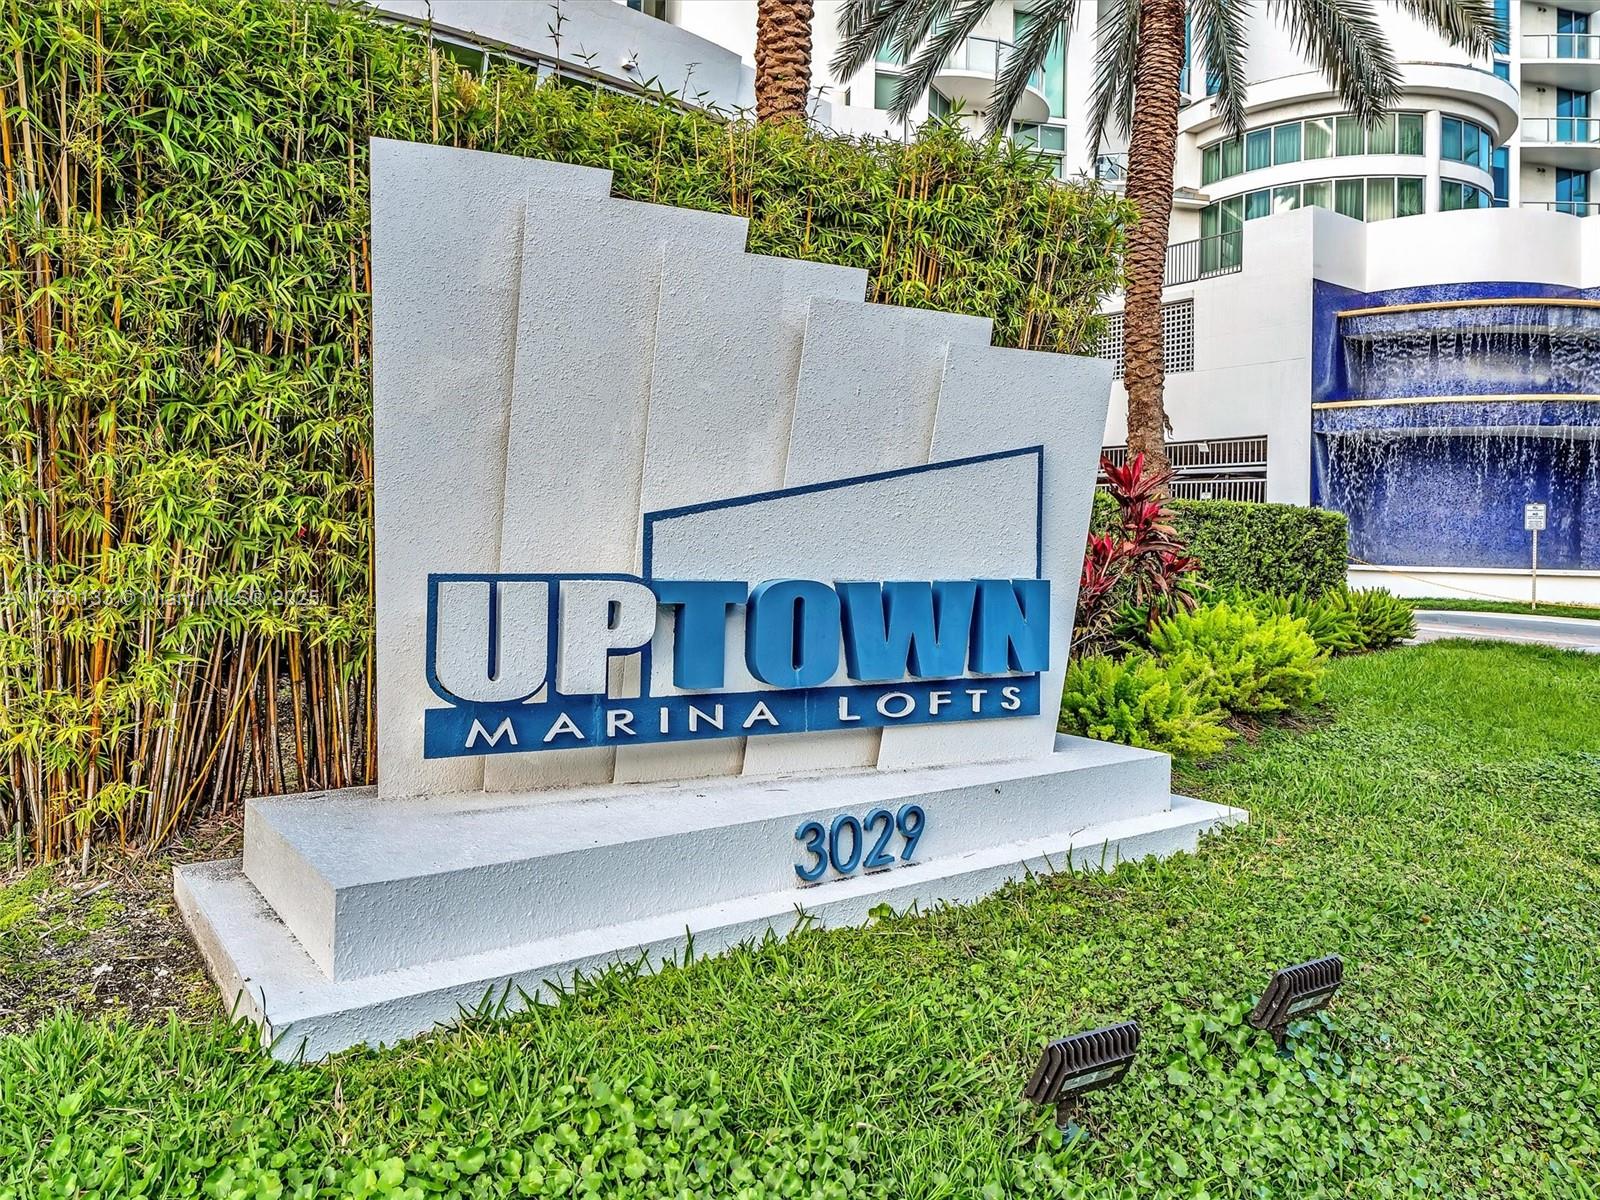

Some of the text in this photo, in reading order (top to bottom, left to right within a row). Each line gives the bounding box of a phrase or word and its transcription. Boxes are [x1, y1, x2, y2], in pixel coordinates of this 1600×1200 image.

[435, 579, 1051, 703] UPTOWN
[465, 686, 1022, 749] MARINA LOFTS
[794, 804, 927, 882] 3029
